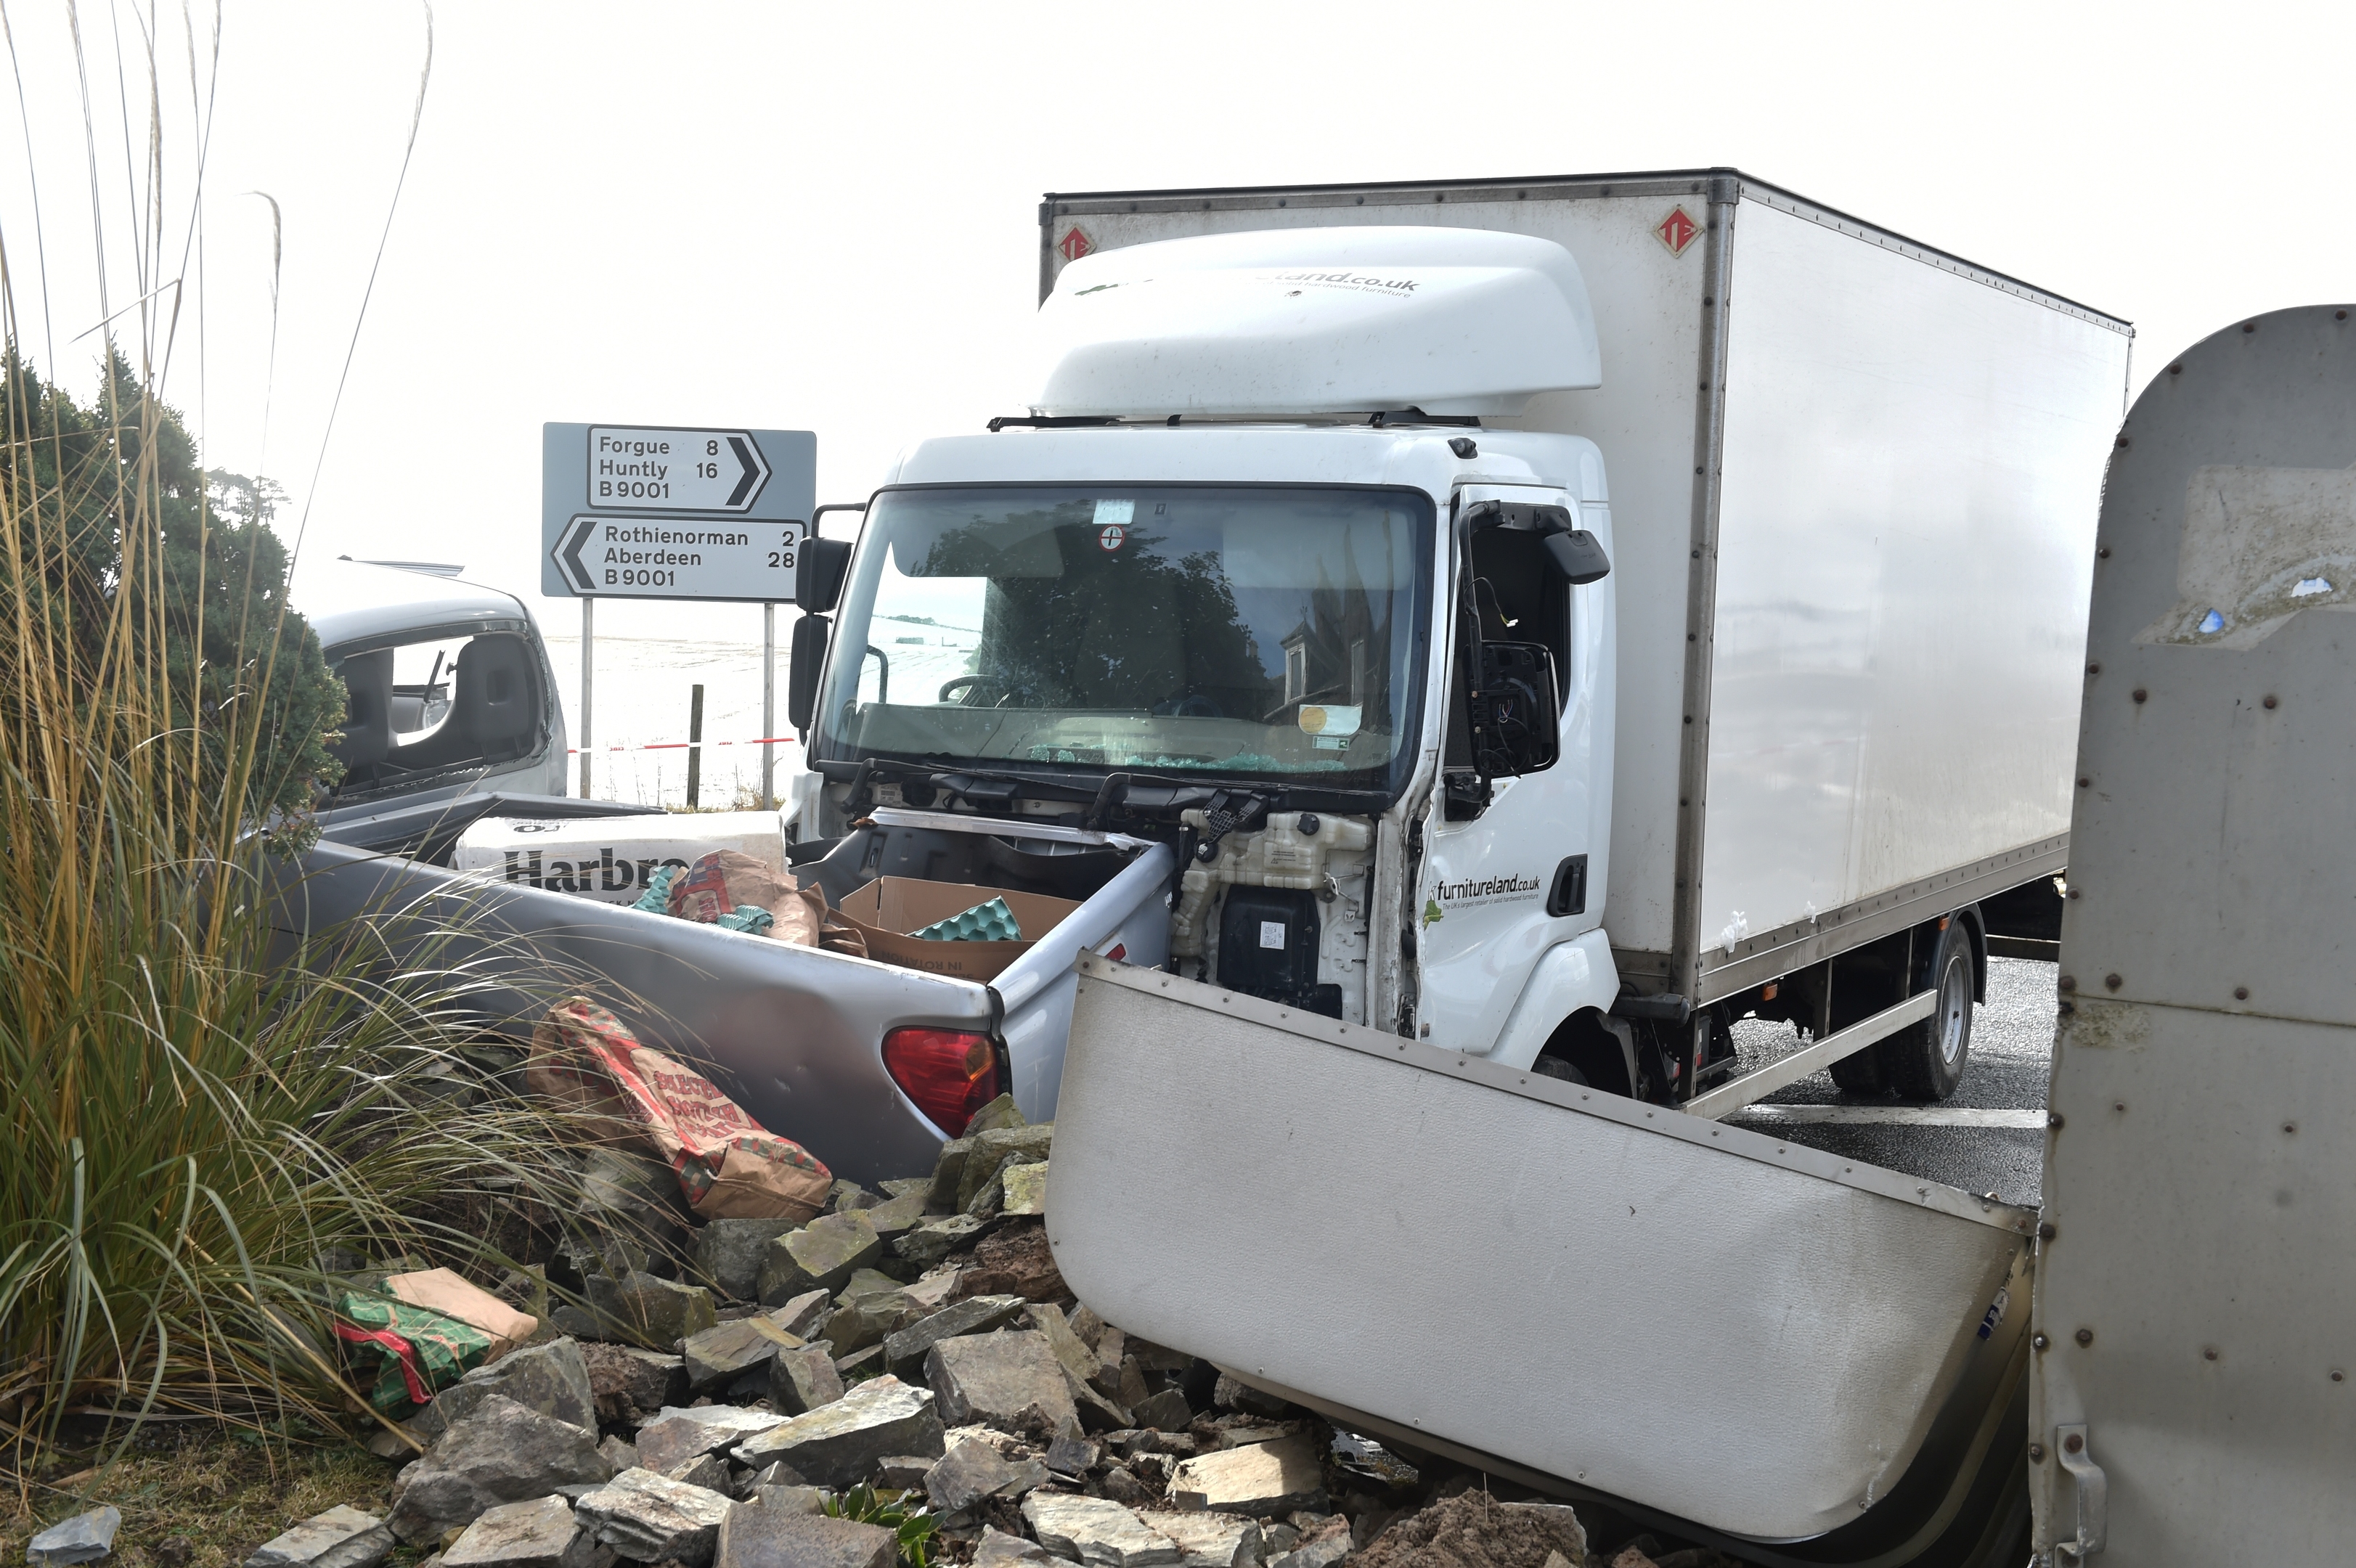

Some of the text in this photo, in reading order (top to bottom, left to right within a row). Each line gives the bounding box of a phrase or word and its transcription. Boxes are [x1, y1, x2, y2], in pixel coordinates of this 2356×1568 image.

[1360, 286, 1411, 298] furniture
[599, 436, 719, 457] Forgue 8
[599, 459, 718, 481] Huntly 16
[605, 526, 794, 547] Rothienorman 2
[603, 547, 794, 568] Aberdeen 28
[881, 951, 962, 971] IN ROTATION
